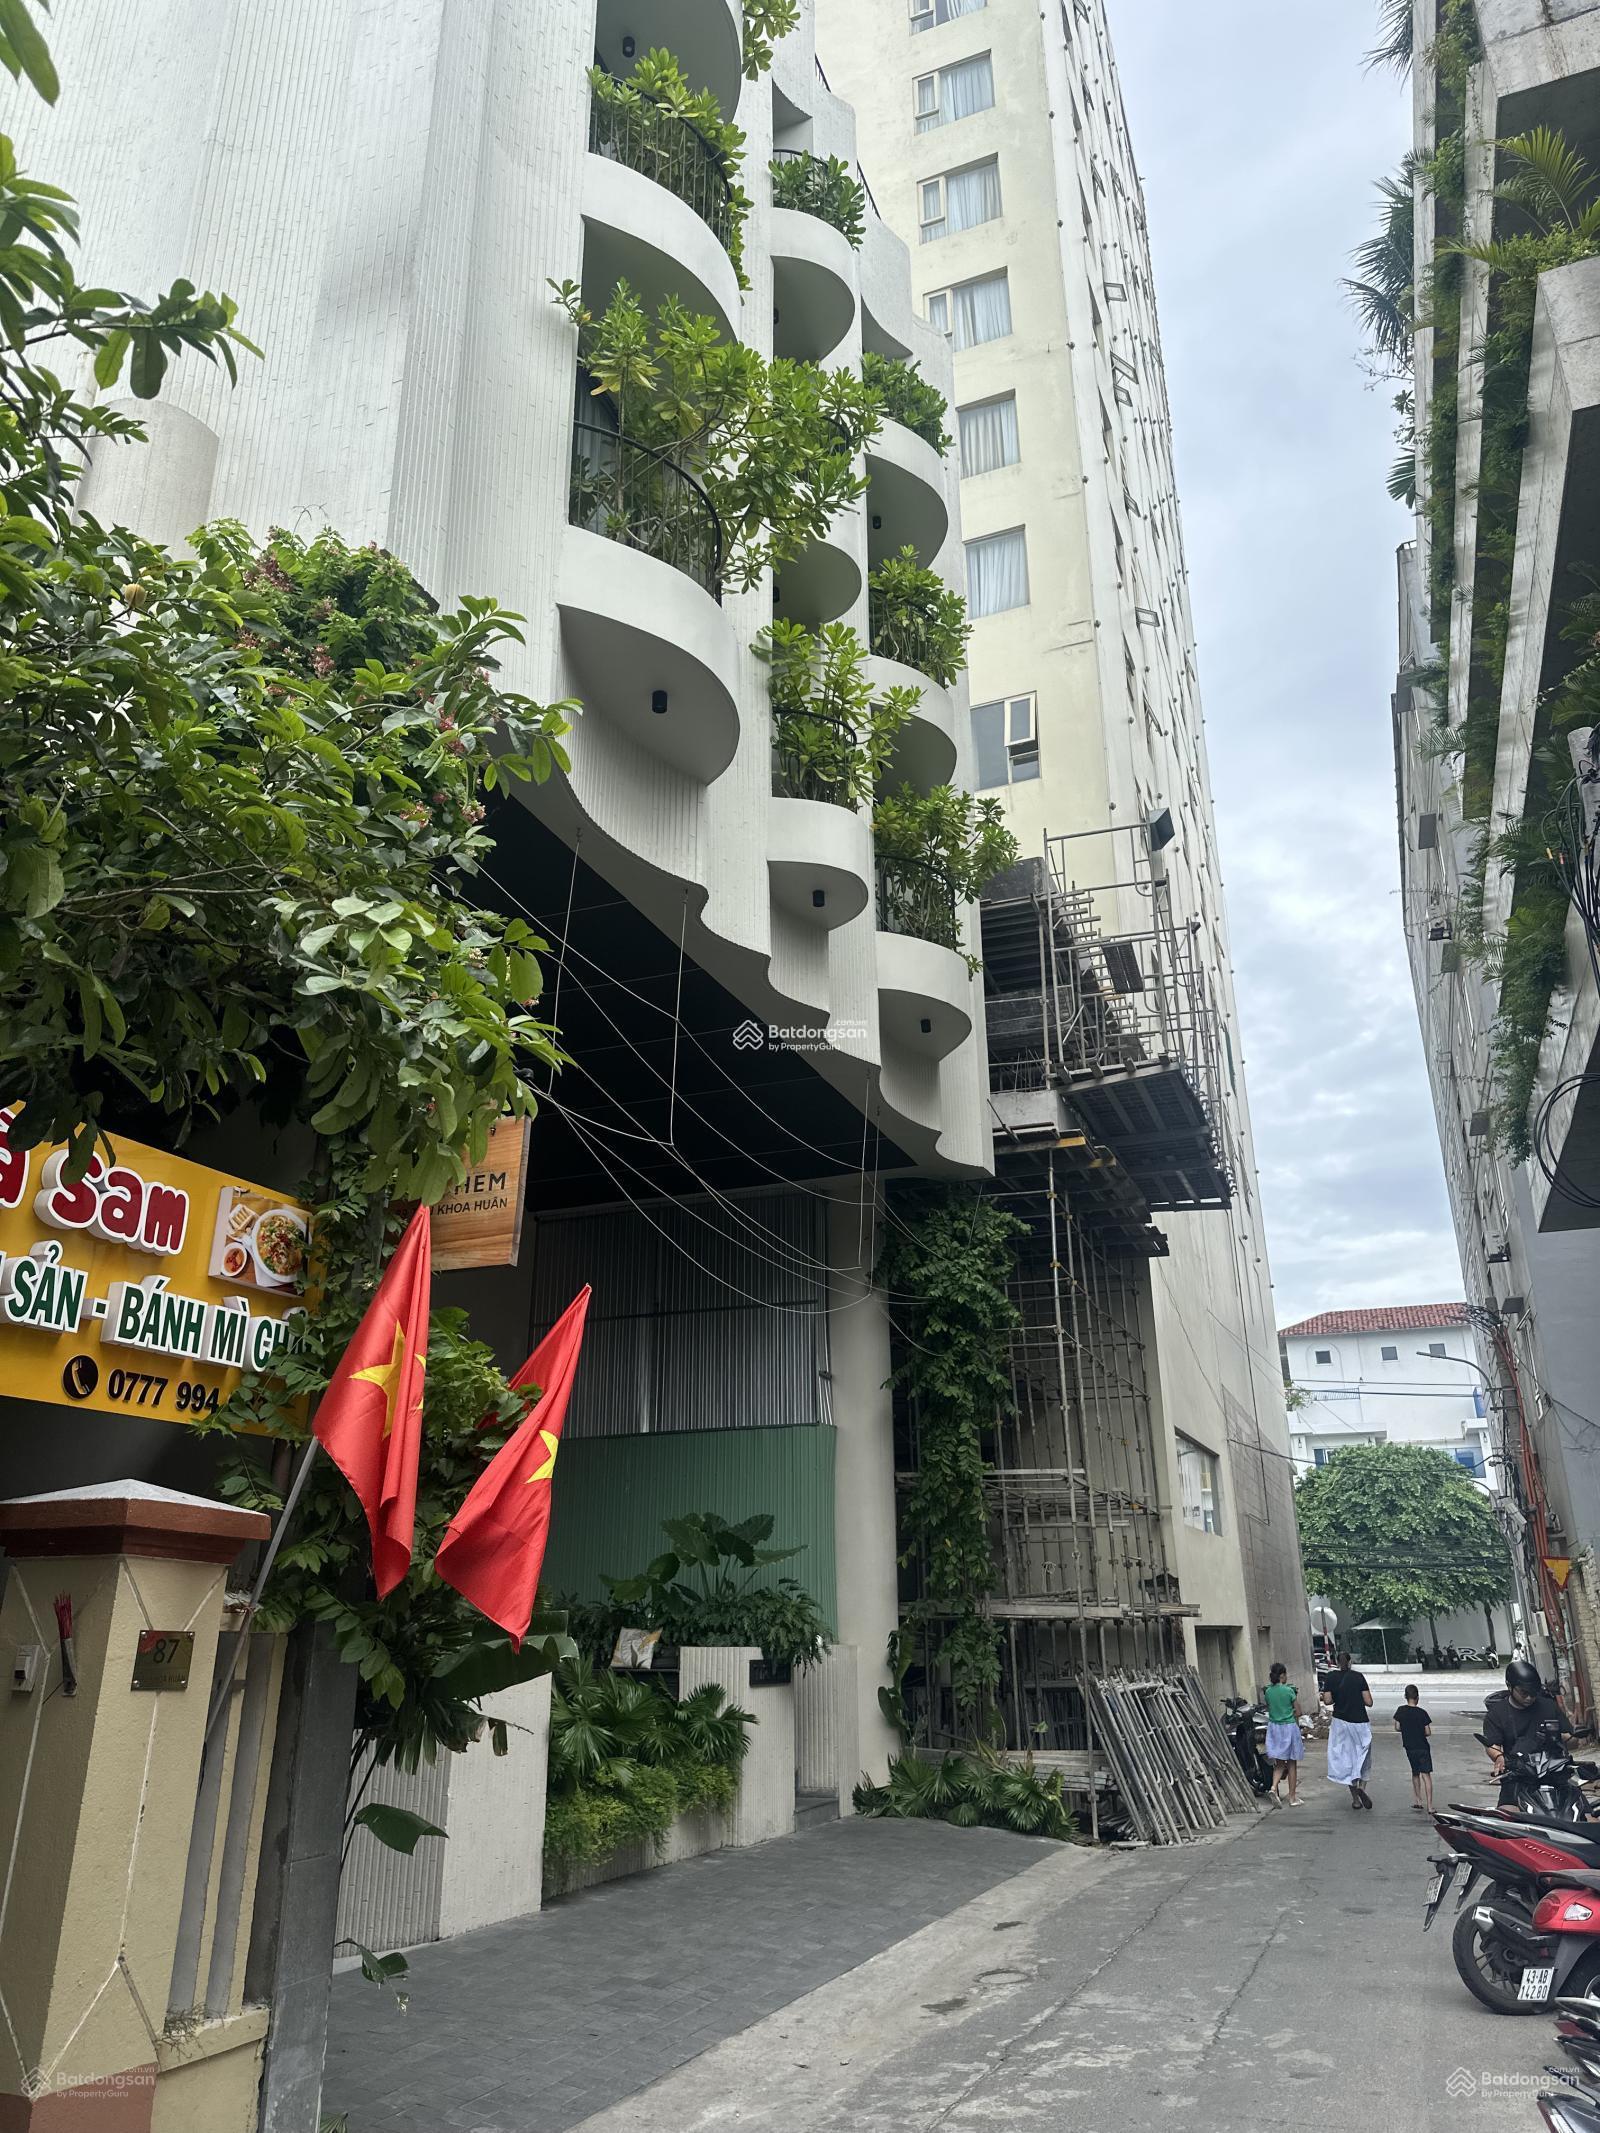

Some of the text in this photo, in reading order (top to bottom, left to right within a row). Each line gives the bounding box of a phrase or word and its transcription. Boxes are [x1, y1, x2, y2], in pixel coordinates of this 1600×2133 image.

[49, 1151, 189, 1254] Sam
[437, 1196, 508, 1215] KHOA HUÂN
[7, 1243, 86, 1331] SẢN
[117, 1278, 206, 1358] BÁNH
[209, 1299, 249, 1365] MÌ
[108, 1368, 220, 1414] 0777 994
[153, 1638, 180, 1664] 87
